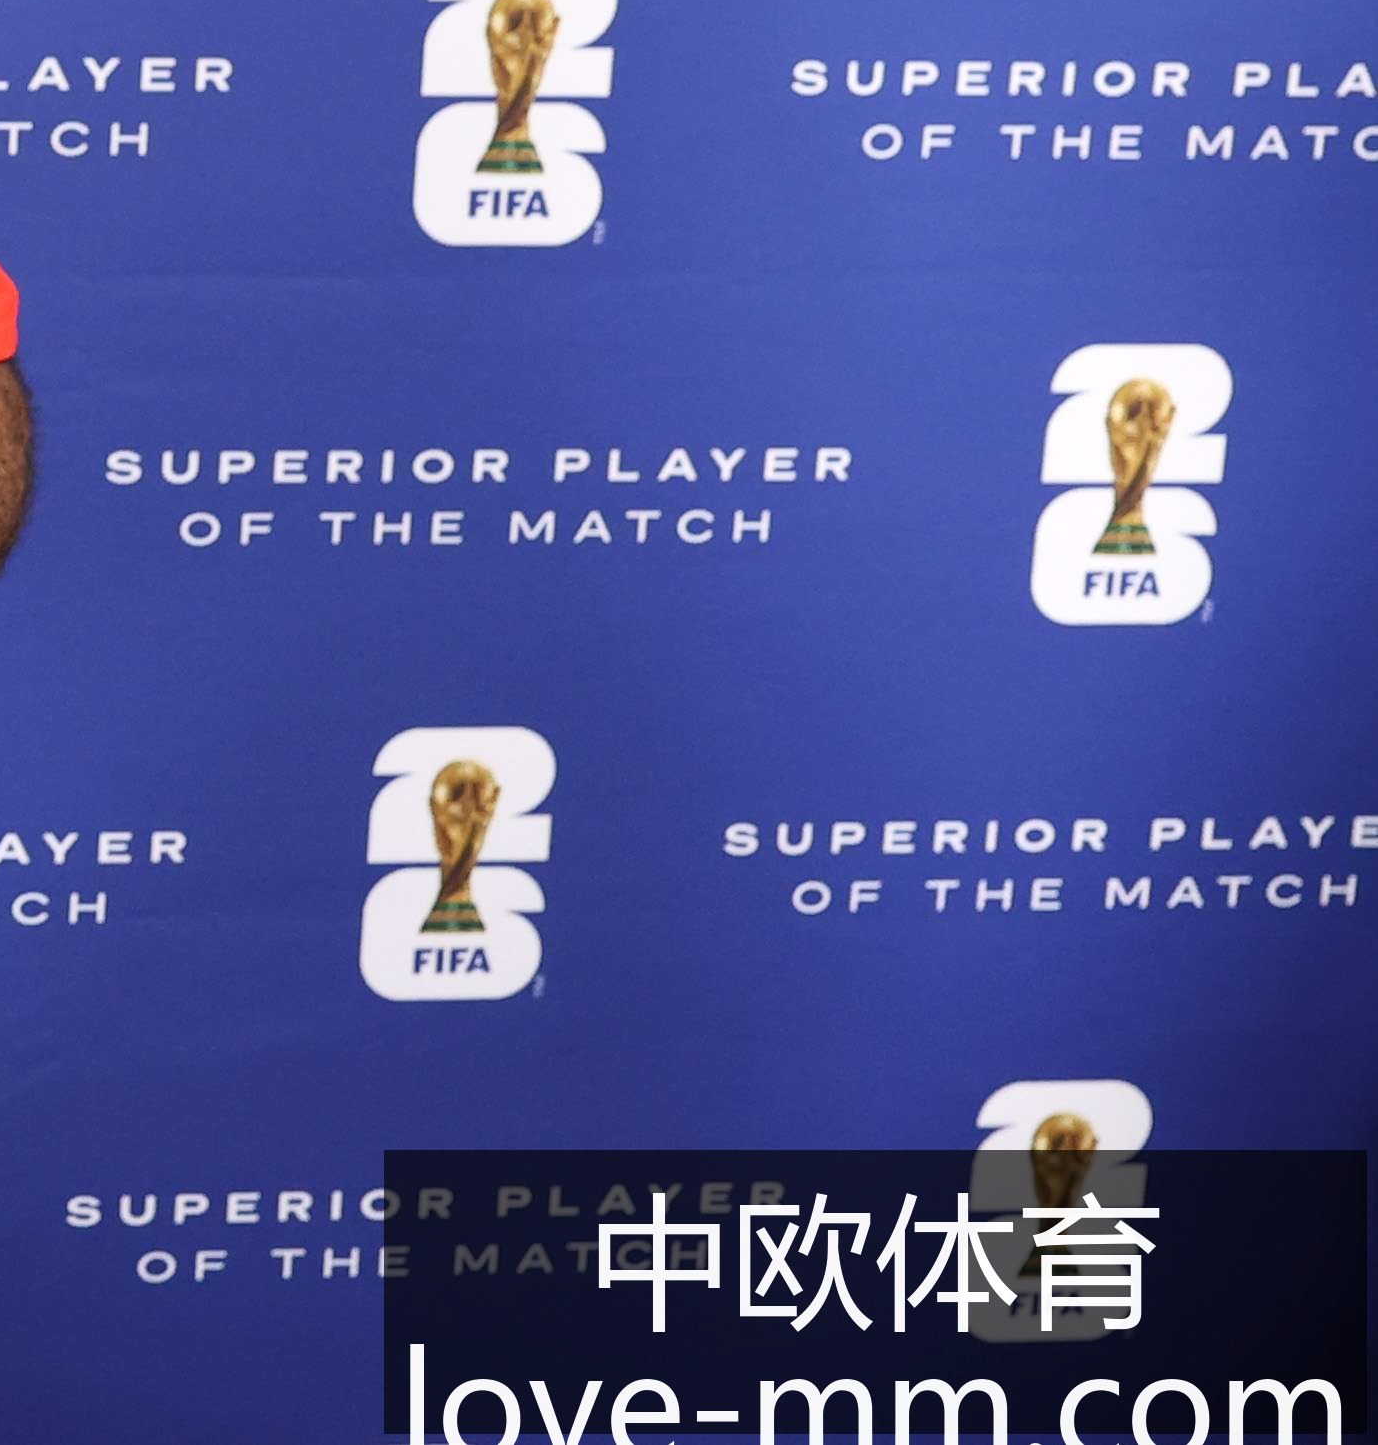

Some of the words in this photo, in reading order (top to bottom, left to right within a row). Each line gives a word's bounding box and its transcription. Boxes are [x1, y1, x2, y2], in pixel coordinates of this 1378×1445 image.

[790, 59, 1190, 98] SUPERIOR
[1232, 61, 1378, 98] PLA
[861, 123, 956, 160] OF
[999, 124, 1143, 161] THE
[1185, 125, 1378, 162] MATC
[468, 189, 549, 218] FIFA
[105, 448, 510, 486] SUPERIOR
[553, 446, 852, 483] PLAYER
[179, 511, 275, 547] OF
[318, 510, 465, 546] THE
[508, 508, 772, 545] MATCH
[1083, 571, 1159, 596] FIFA
[723, 818, 1108, 857] SUPERIOR
[1149, 815, 1378, 852] PLAYE
[791, 879, 883, 915] OF
[924, 877, 1064, 913] THE
[1104, 873, 1358, 910] MATCH
[413, 947, 491, 974] FIFA
[65, 1186, 455, 1228] SUPERIOR
[136, 1249, 229, 1284] OF
[270, 1245, 412, 1280] THE
